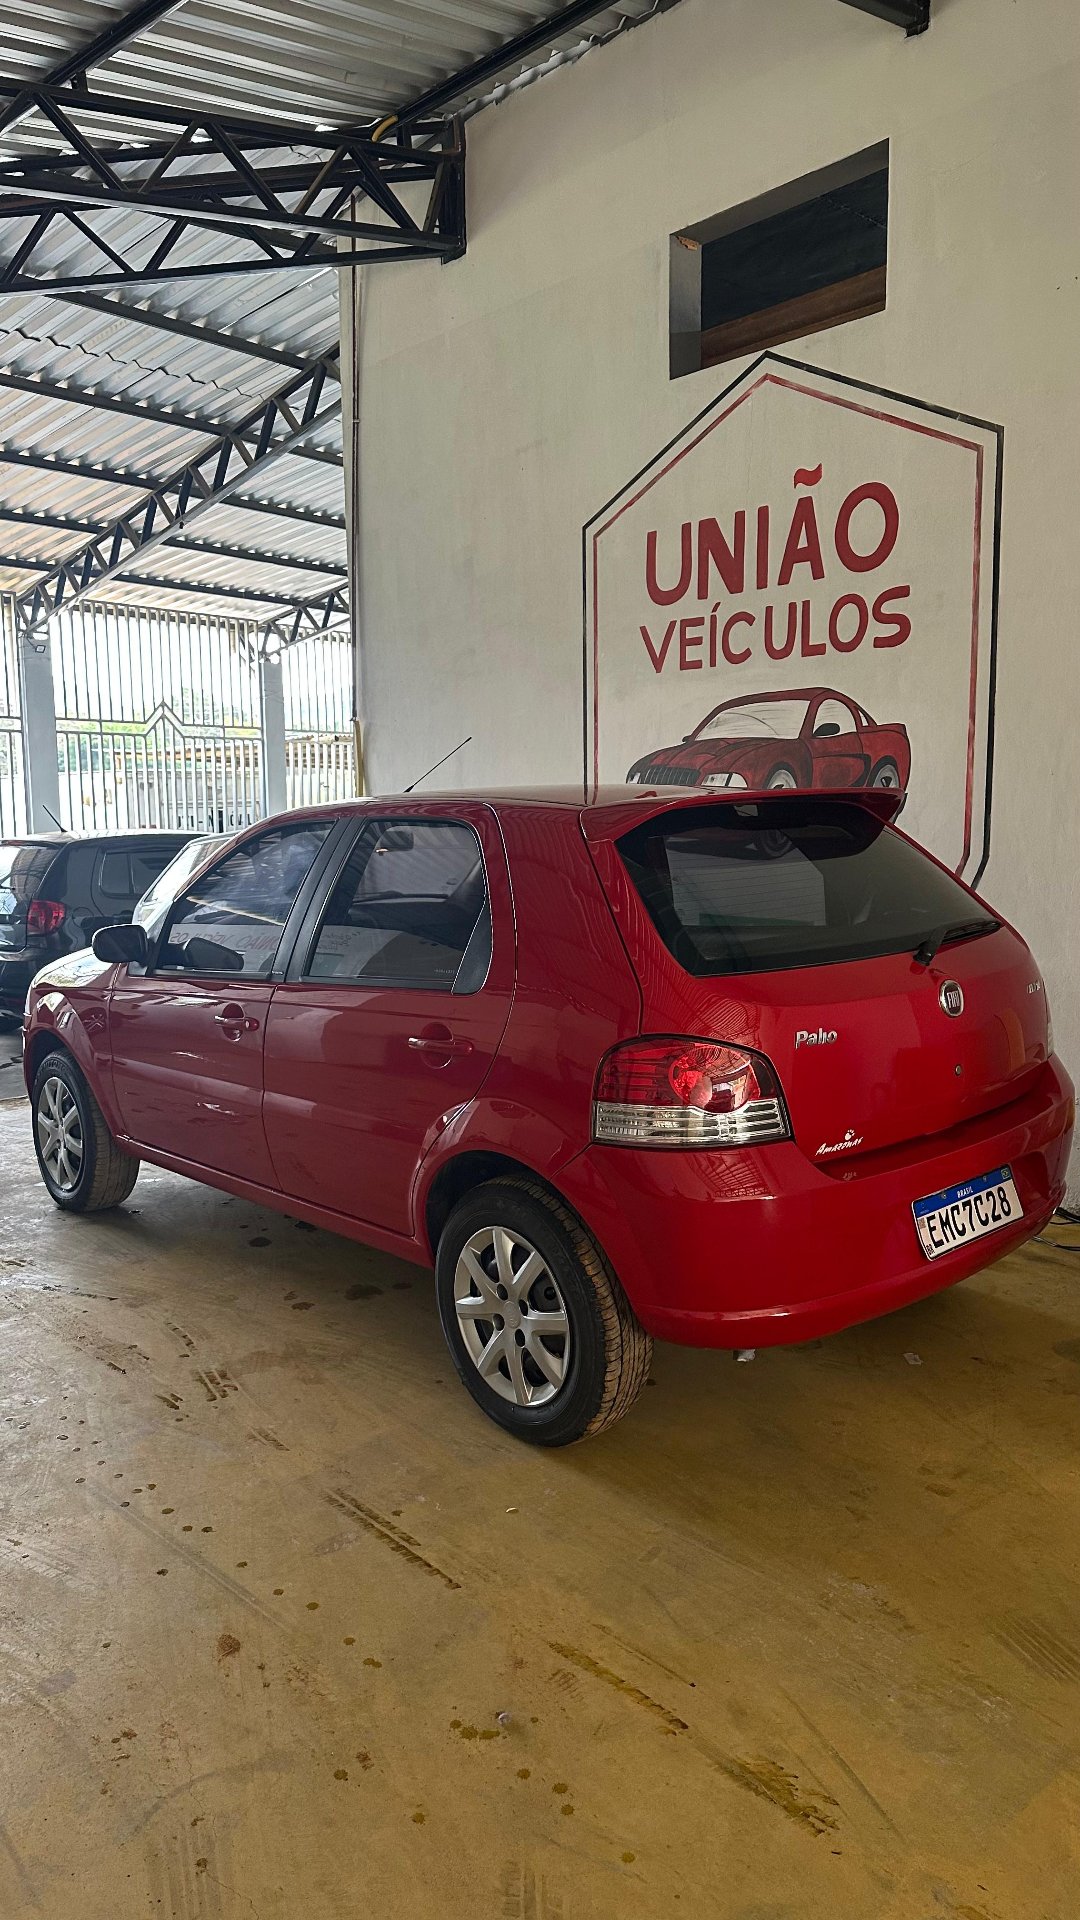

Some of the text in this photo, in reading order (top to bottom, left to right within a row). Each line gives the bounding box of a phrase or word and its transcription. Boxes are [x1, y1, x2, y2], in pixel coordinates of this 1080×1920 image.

[645, 463, 900, 606] UNIÃO
[639, 584, 911, 674] VEÍCULOS
[795, 1027, 838, 1050] Palio
[926, 1186, 1012, 1249] EMC7C28
[956, 1186, 974, 1199] BRASIL
